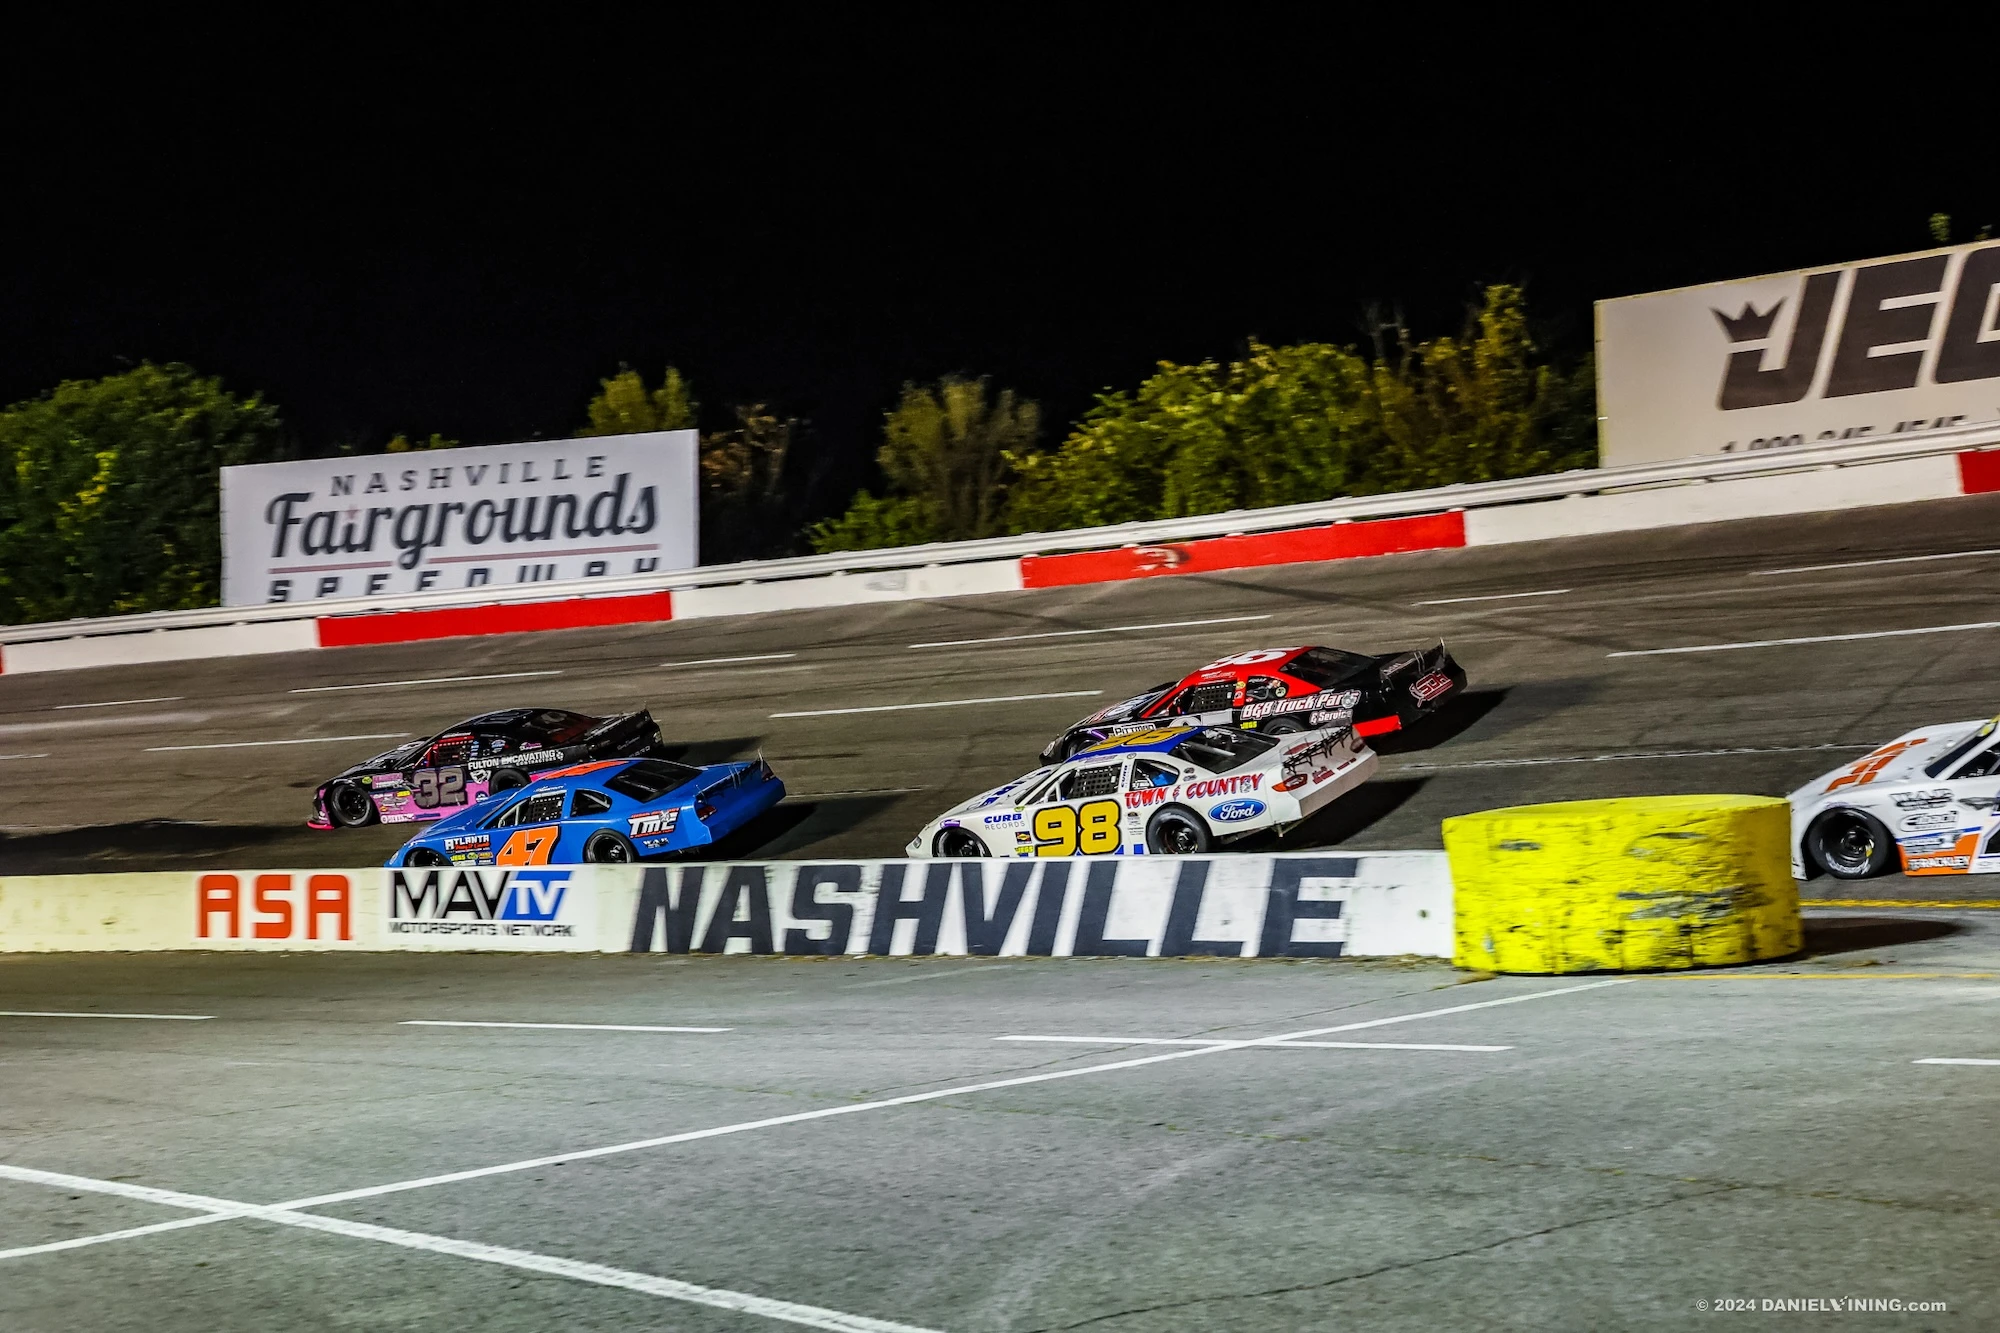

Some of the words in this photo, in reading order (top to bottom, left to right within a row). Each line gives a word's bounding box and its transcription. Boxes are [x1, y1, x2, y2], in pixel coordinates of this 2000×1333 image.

[329, 455, 607, 496] NASHVILLE
[266, 472, 658, 570] Fairgrounds
[1242, 701, 1274, 718] B&B
[1274, 696, 1317, 713] Truck
[1310, 714, 1318, 723] &
[468, 758, 499, 770] FULTON
[501, 750, 555, 765] EXCAVATING
[516, 757, 557, 766] CONTRACTORS
[413, 767, 467, 809] 32
[1124, 787, 1169, 809] TOWN
[1186, 773, 1264, 800] COUNTRY
[984, 814, 1023, 823] CURB
[1219, 802, 1256, 820] Ford
[984, 821, 1026, 831] RECORDS
[1034, 799, 1121, 857] 98
[444, 834, 490, 850] ATLANTA
[496, 825, 559, 866] 47
[195, 873, 351, 940] ASA
[631, 858, 1360, 957] NASHVILLE
[389, 922, 497, 936] MOTORSPORTS
[501, 923, 576, 937] NETWORK
